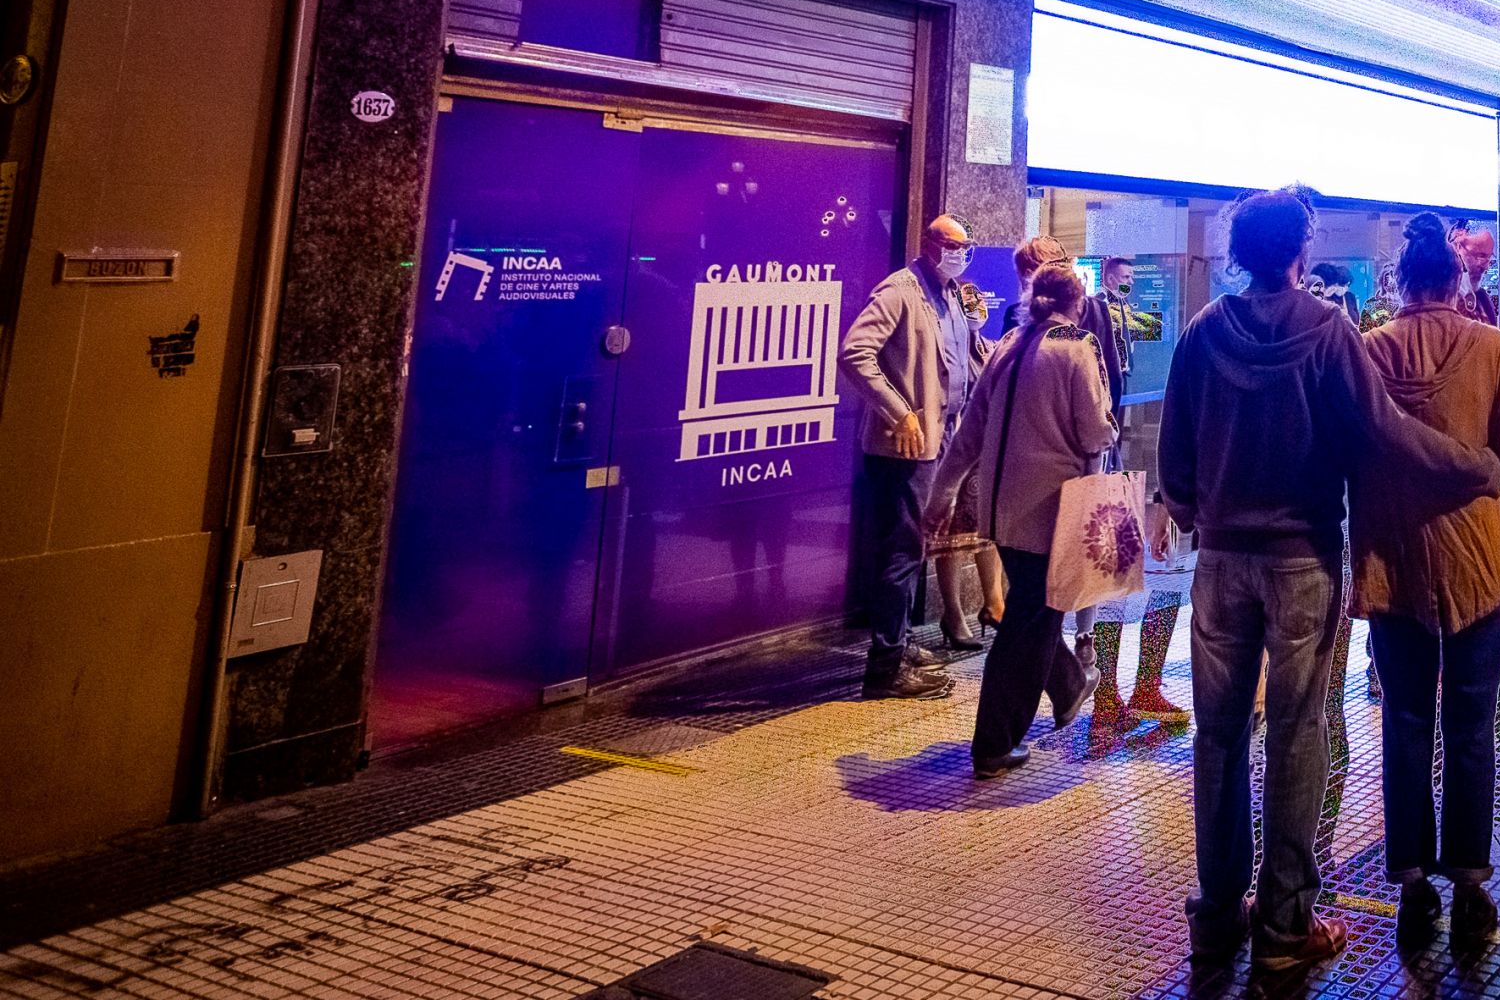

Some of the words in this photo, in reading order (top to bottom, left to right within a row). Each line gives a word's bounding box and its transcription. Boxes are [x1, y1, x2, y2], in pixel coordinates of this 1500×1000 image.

[355, 97, 391, 117] 1637
[502, 256, 562, 270] INCAA
[501, 273, 552, 282] INSTITUTO
[553, 273, 602, 281] NACIONAL
[706, 263, 836, 283] GAUMONT
[500, 283, 513, 291] DE
[498, 291, 576, 300] AUDIOVISUALES
[721, 459, 793, 487] INCAA
